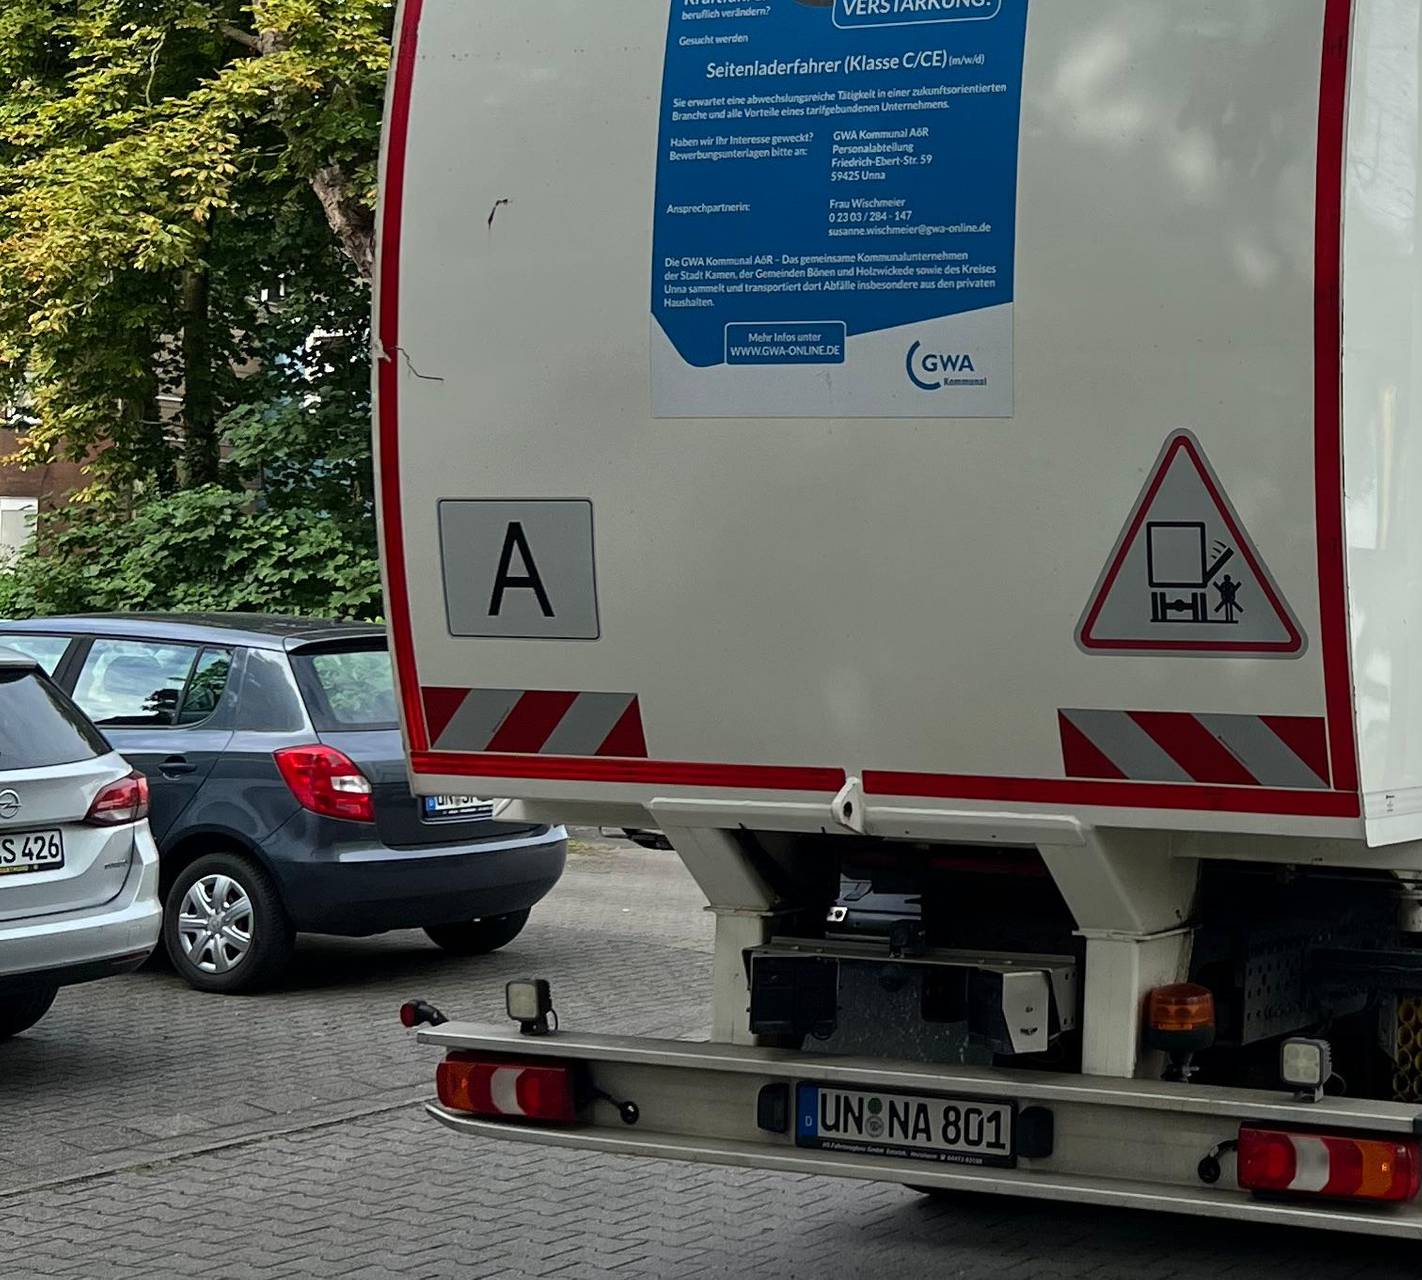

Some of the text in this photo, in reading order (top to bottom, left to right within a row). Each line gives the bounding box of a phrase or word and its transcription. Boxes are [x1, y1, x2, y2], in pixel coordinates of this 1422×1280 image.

[681, 6, 771, 20] beruflich verändern?
[679, 34, 749, 46] Gesucht werden
[706, 49, 985, 78] Seitenladerfahrer (Klasse C/CE) (m/w/d)
[672, 83, 1007, 108] Sie erwartet eine abwechslungsreiche Tätigkeit in einer zukunftsorientierten
[672, 100, 950, 121] Branche und alle Vorteile eines tarifgebundenen Unternehmens.
[670, 131, 814, 147] Haben wir Ihr Interesse geweckt?
[833, 126, 930, 141] GWA Kommunal AöR
[669, 147, 808, 161] Bewerbungsunterlagen bitte an:
[832, 142, 914, 155] Personalabteilung
[832, 154, 933, 168] Friedrich-Ebert-Str. 59
[831, 170, 886, 181] 59425 Unna
[666, 202, 750, 215] Ansprechpartnerin:
[829, 197, 907, 209] Frau Wischmeier
[828, 212, 836, 223] 0
[836, 212, 850, 223] 23
[850, 211, 863, 222] 03
[869, 211, 888, 222] 284
[895, 210, 913, 221] 147
[828, 222, 992, 236] susanne.wischmeier@gwa-online.de
[664, 257, 680, 268] Die
[681, 256, 705, 267] GWA
[705, 255, 753, 266] Kommunal
[754, 254, 774, 265] AöR
[782, 254, 799, 264] Das
[800, 252, 856, 265] gemeinsame
[857, 250, 969, 262] Kommunalunternehmen
[664, 263, 997, 281] der Stadt Kamen, der Gemeinden Bönen und Holzwickede sowie des Kreises
[664, 277, 996, 294] Unna sammelt und transportiert dort Abfälle insbesondere aus den privaten
[664, 298, 715, 308] Haushalten.
[748, 332, 822, 343] Mehr Infos unter
[730, 346, 840, 356] WWW.GWA-ONLINE.DE
[921, 354, 975, 372] GWA
[943, 377, 987, 386] Kommunal
[488, 521, 555, 617] A
[0, 834, 60, 864] S 426
[804, 1093, 1006, 1150] D UN NA 801
